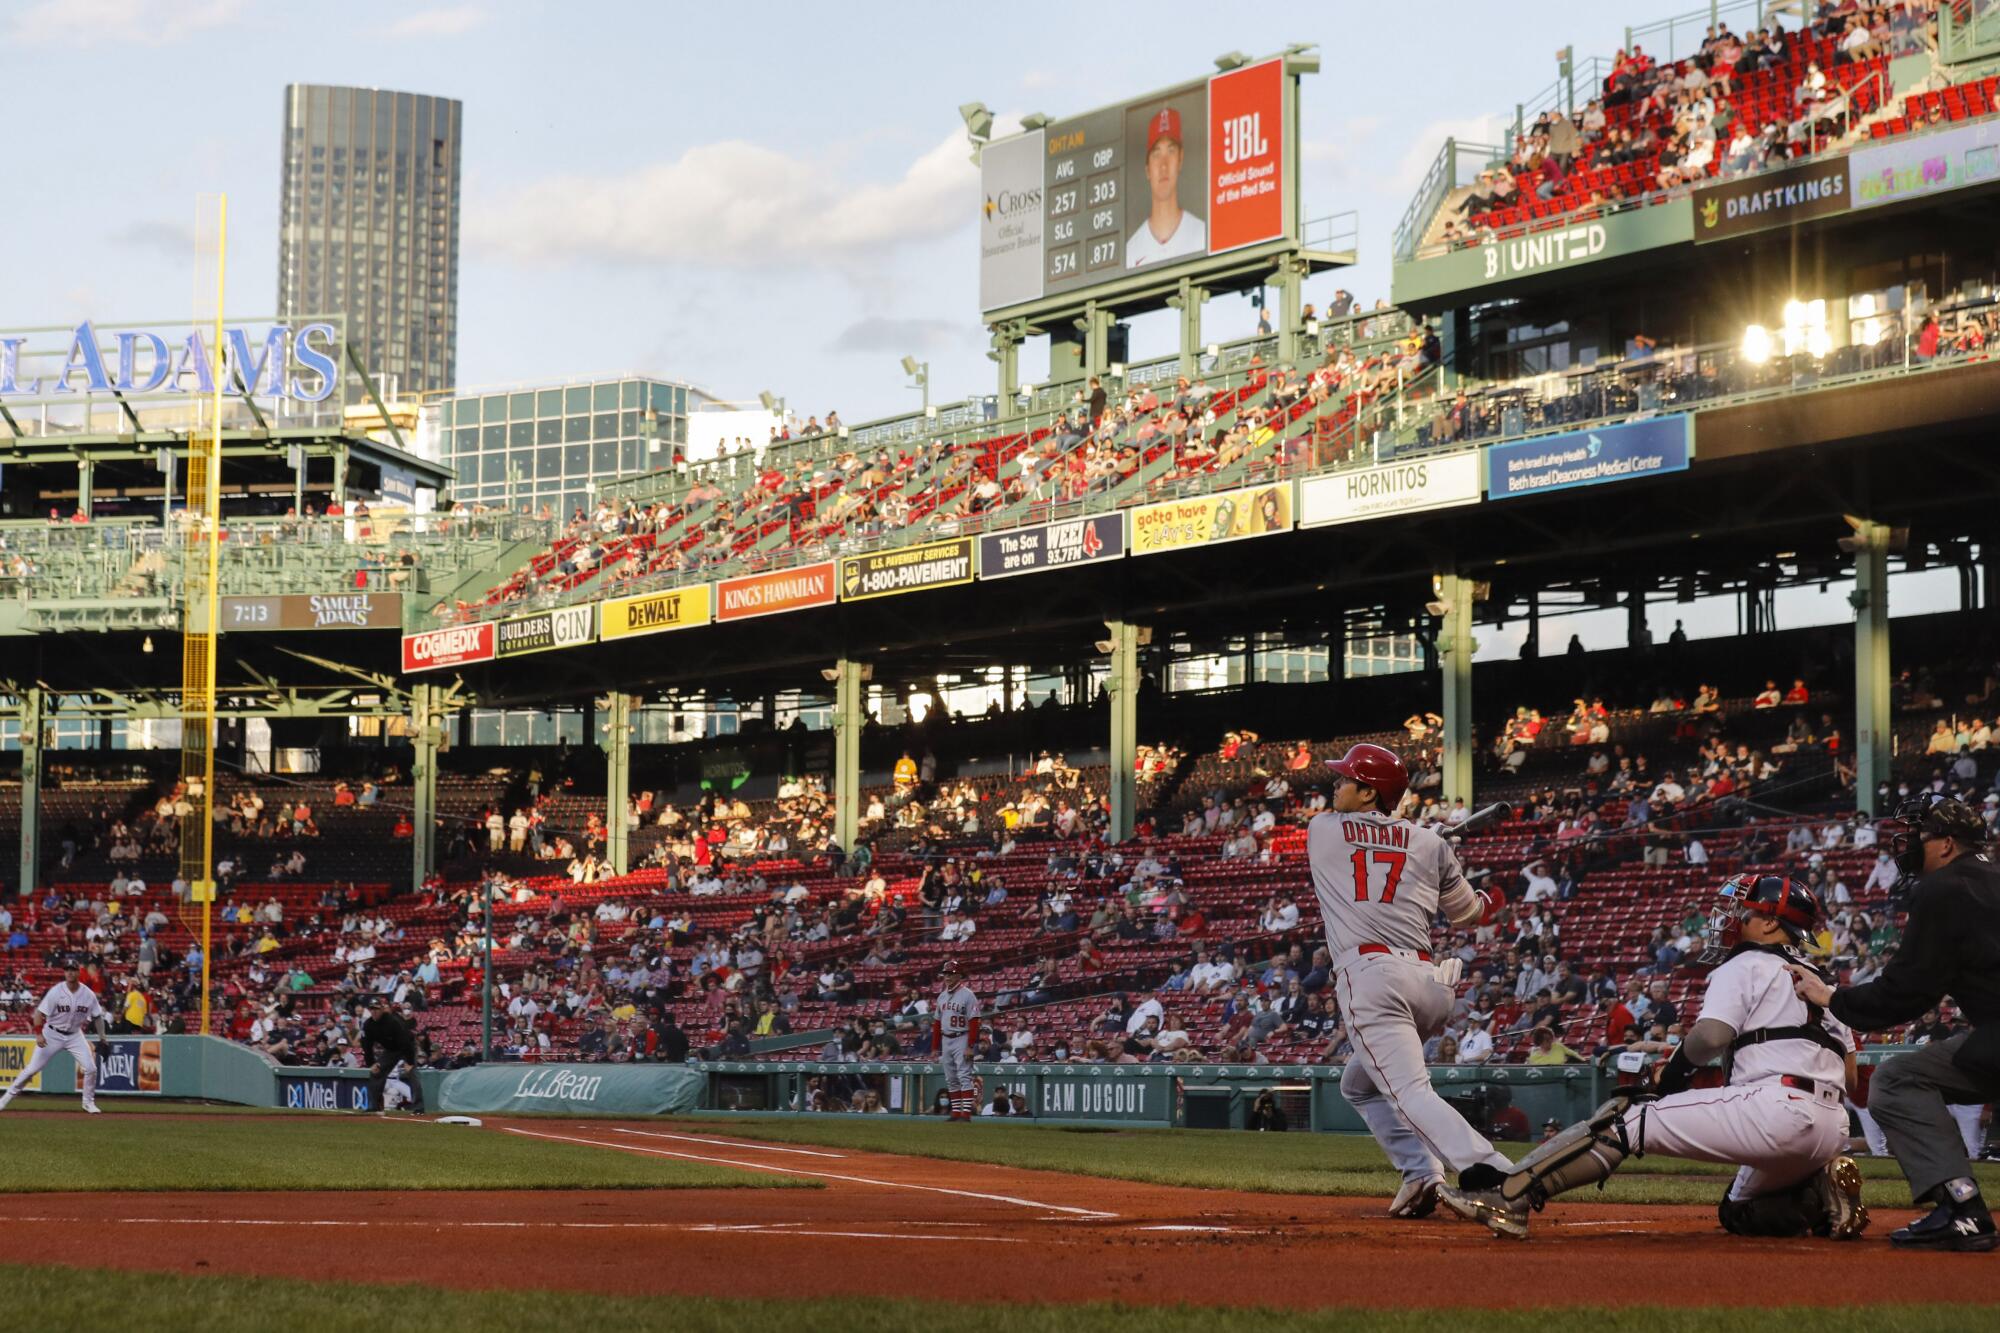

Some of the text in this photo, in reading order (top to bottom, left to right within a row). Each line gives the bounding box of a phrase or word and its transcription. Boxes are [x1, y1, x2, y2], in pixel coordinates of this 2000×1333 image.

[1048, 131, 1085, 155] OHTANI
[1223, 112, 1268, 164] JBL
[1055, 148, 1113, 180] AVG OBP
[1218, 161, 1275, 187] Official Sound
[1051, 191, 1077, 216] .257
[1089, 180, 1116, 204] .303
[1216, 180, 1276, 205] of the Red Sox
[1726, 174, 1844, 219] DRAFTKINGS
[1054, 210, 1113, 240] SLG OPS
[1051, 241, 1116, 275] .574 .877
[0, 319, 338, 402] L ADAMS
[1508, 448, 1587, 472] Beth Israel Lahey Health
[1508, 455, 1663, 491] Beth Israel Deaconess Medical Center
[1347, 464, 1428, 499] HORNITOS
[1137, 504, 1207, 530] gotta have
[999, 534, 1039, 554] The Sox
[1046, 521, 1085, 549] WEEI
[1153, 523, 1195, 545] LAY'S
[870, 545, 960, 570] U.S. PAVEMENT SERVICES
[1003, 552, 1035, 569] are on
[861, 557, 969, 592] 1-800-PAVEMENT
[310, 594, 373, 613] SAMUEL
[725, 575, 825, 610] KING'S HAWAIIAN
[233, 605, 368, 628] 7:13 ADAMS
[500, 617, 550, 641] BUILDERS
[555, 609, 588, 642] GIN
[413, 628, 480, 660] COGMEDIX
[500, 635, 550, 651] BOTANICAL
[1342, 820, 1410, 849] OHTANI
[1350, 848, 1407, 904] 17
[304, 1081, 338, 1109] Mitel
[1043, 1082, 1075, 1112] EAM
[1082, 1083, 1146, 1113] DUGOUT
